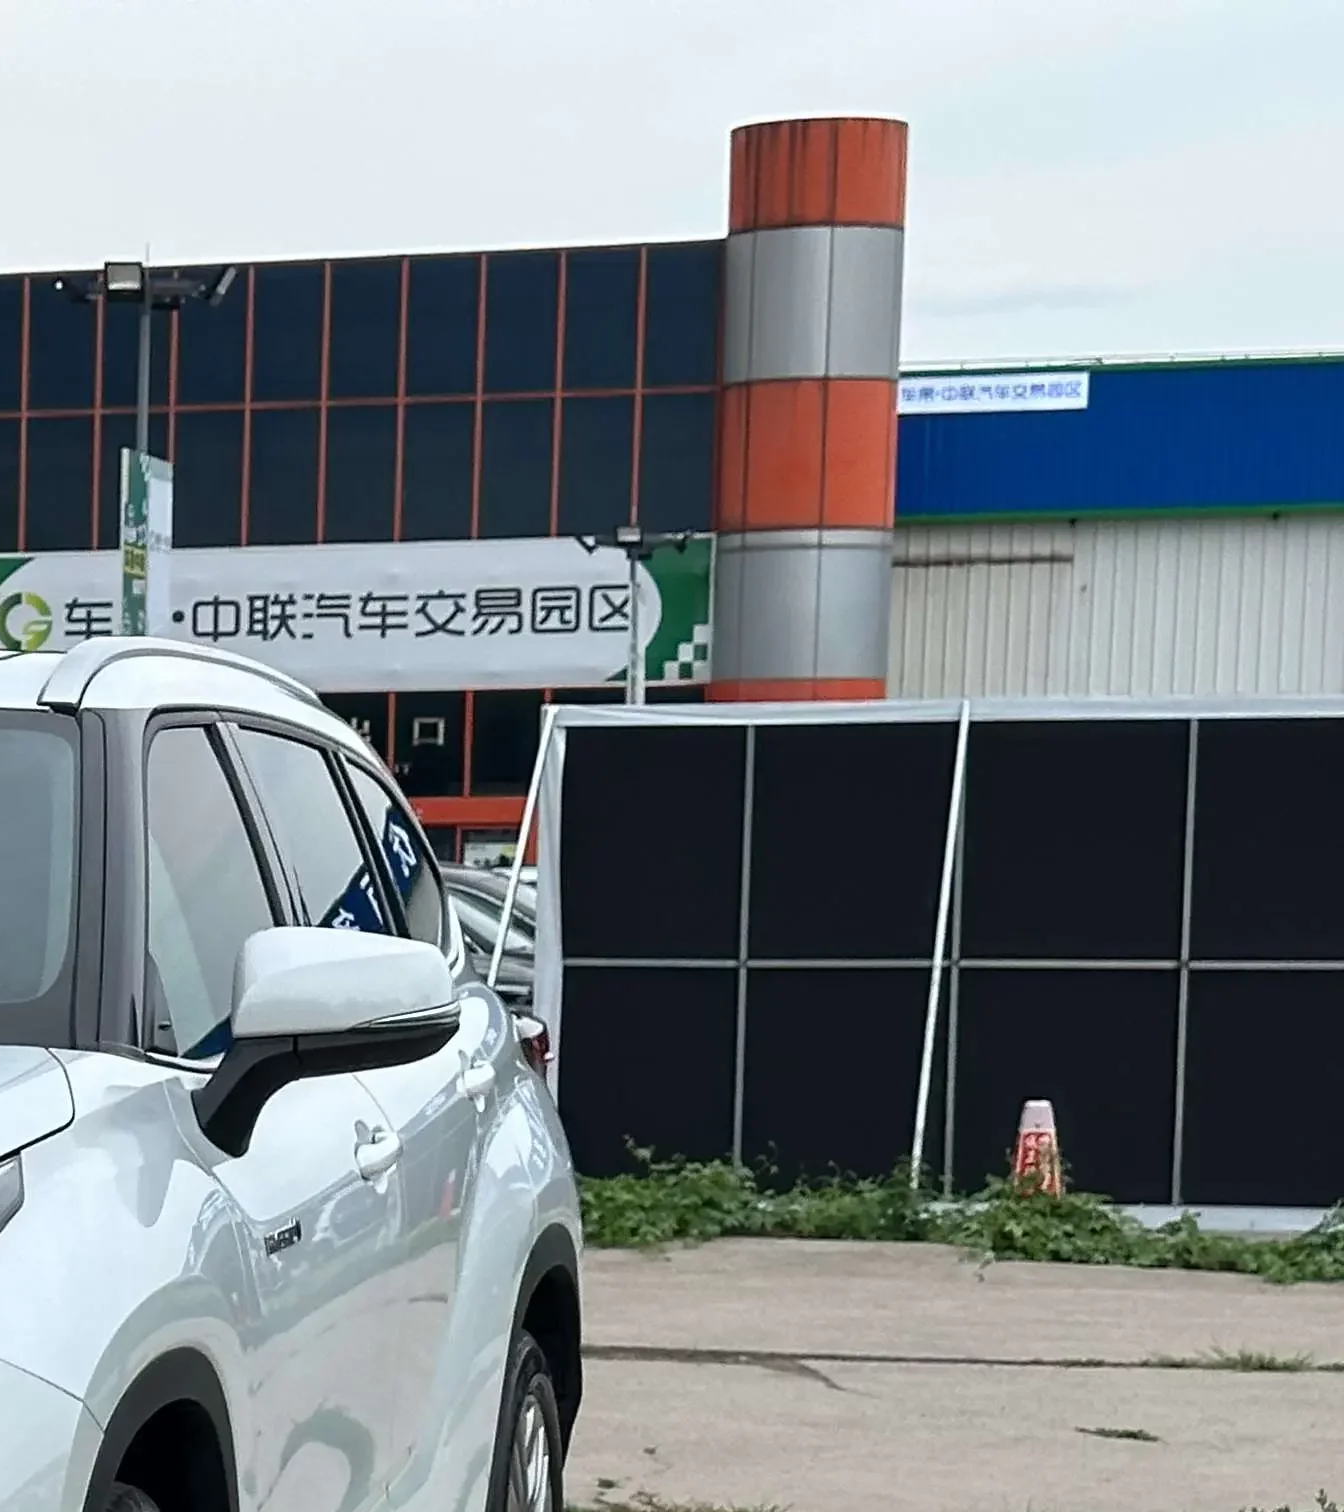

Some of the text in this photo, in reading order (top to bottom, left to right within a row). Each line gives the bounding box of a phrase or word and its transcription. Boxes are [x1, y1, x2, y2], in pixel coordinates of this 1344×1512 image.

[63, 582, 631, 642] 车·中联汽车交易园区
